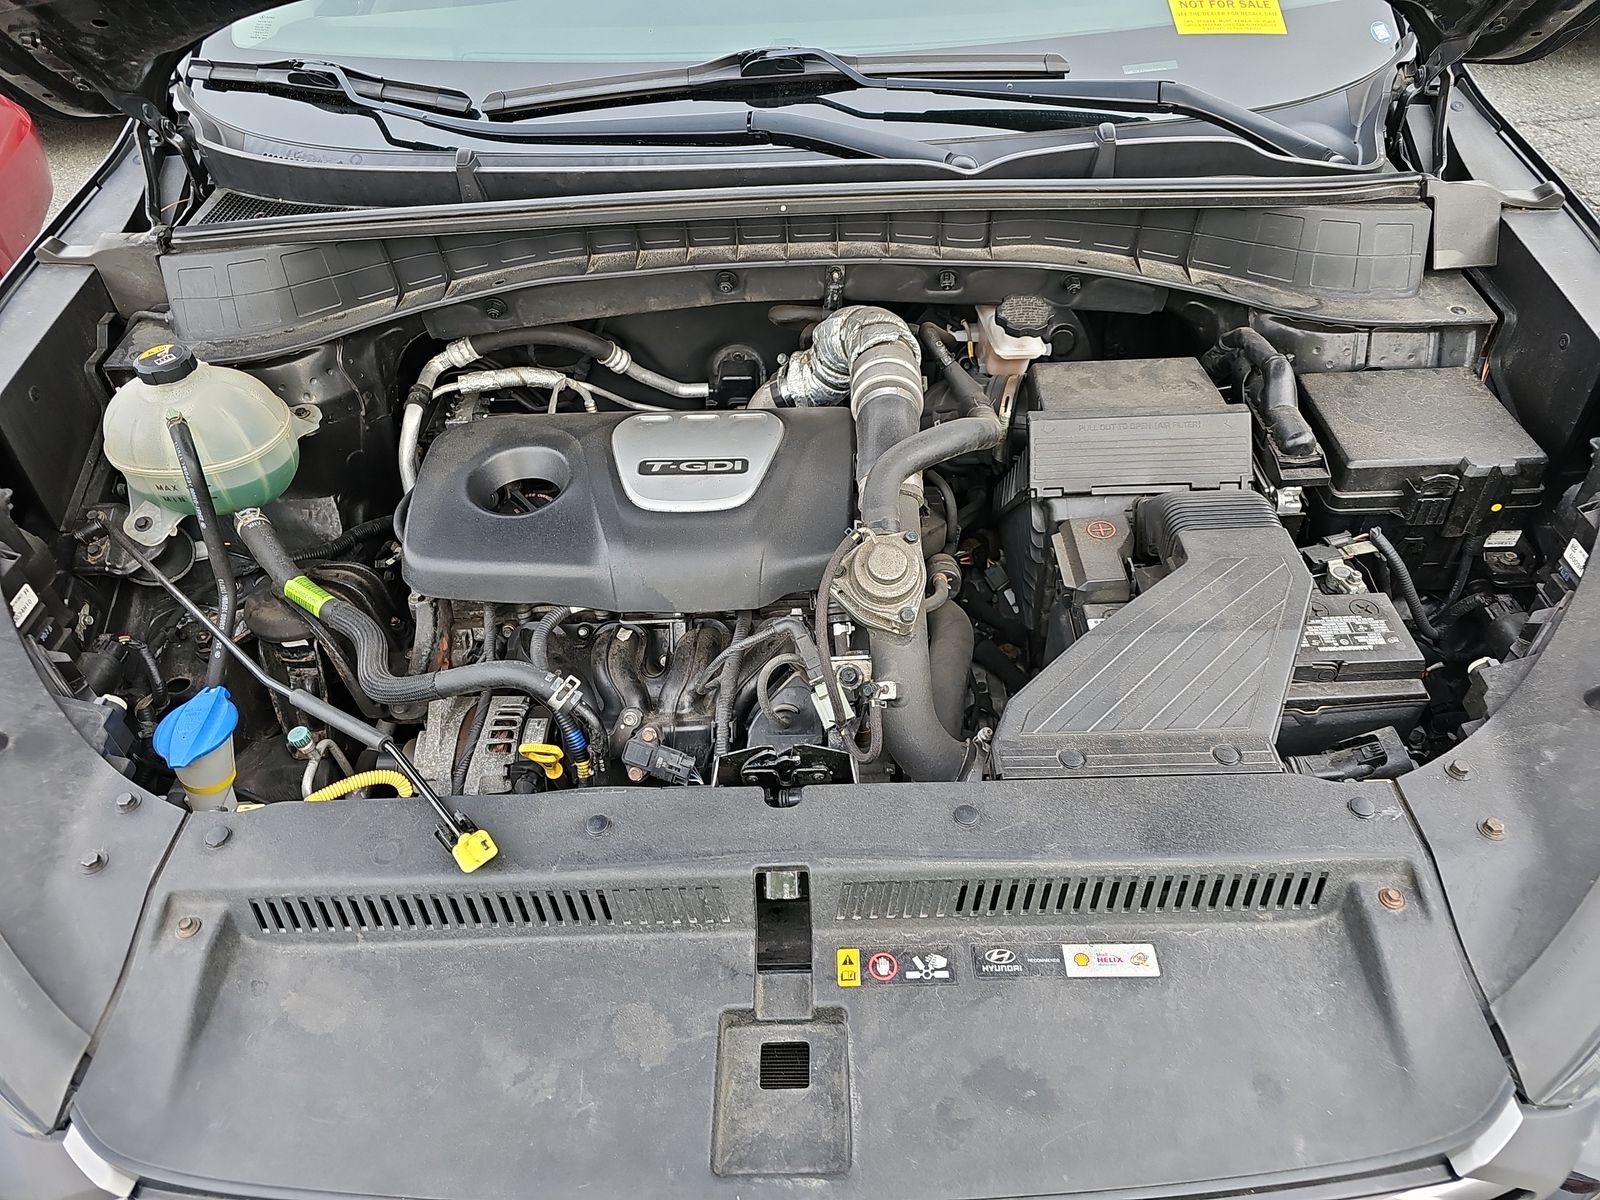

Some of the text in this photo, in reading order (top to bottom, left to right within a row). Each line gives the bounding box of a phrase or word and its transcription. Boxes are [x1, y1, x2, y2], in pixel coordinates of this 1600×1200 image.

[1179, 0, 1272, 9] NOT FOR SALE
[1078, 424, 1099, 432] PULL
[1100, 423, 1116, 431] OUT
[1118, 422, 1129, 431] TO
[1130, 422, 1152, 430] OPEN
[646, 461, 743, 472] T-GDI
[982, 964, 1023, 972] HYUNDAI
